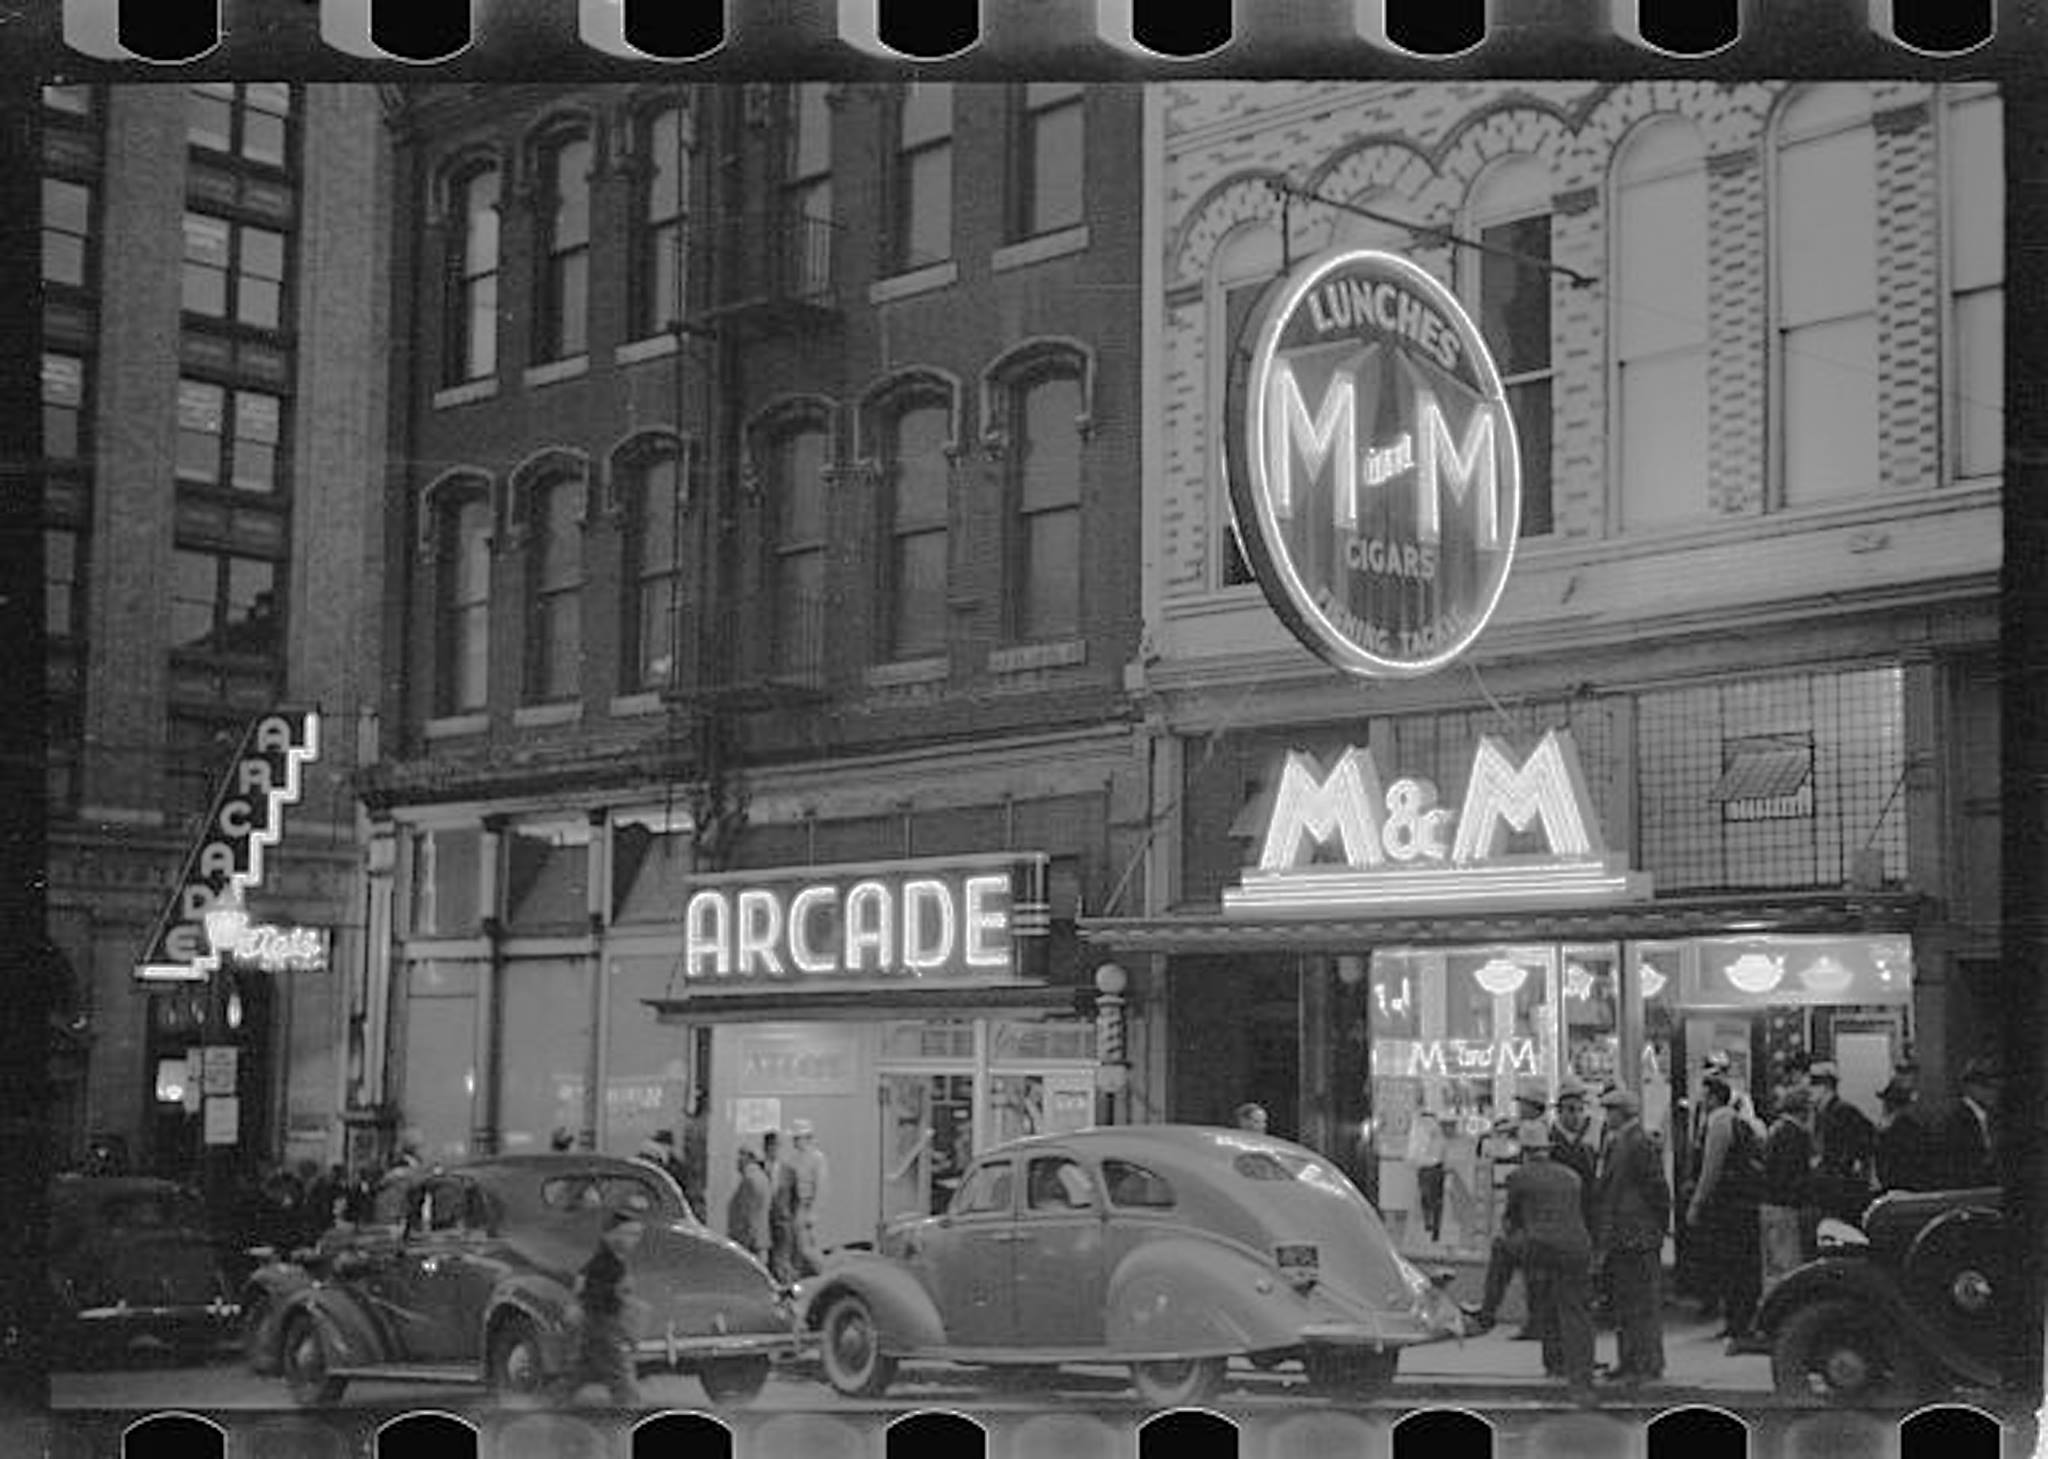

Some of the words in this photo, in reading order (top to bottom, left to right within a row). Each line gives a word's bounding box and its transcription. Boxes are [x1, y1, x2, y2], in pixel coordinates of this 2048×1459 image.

[1307, 280, 1461, 369] LUNCHES
[1270, 358, 1360, 531] M
[1415, 388, 1505, 552] M
[1344, 537, 1438, 581] CIGARS
[164, 714, 292, 962] ARCADE
[684, 873, 1014, 978] ARCADE
[1407, 1040, 1447, 1076] M
[1498, 1038, 1538, 1076] M
